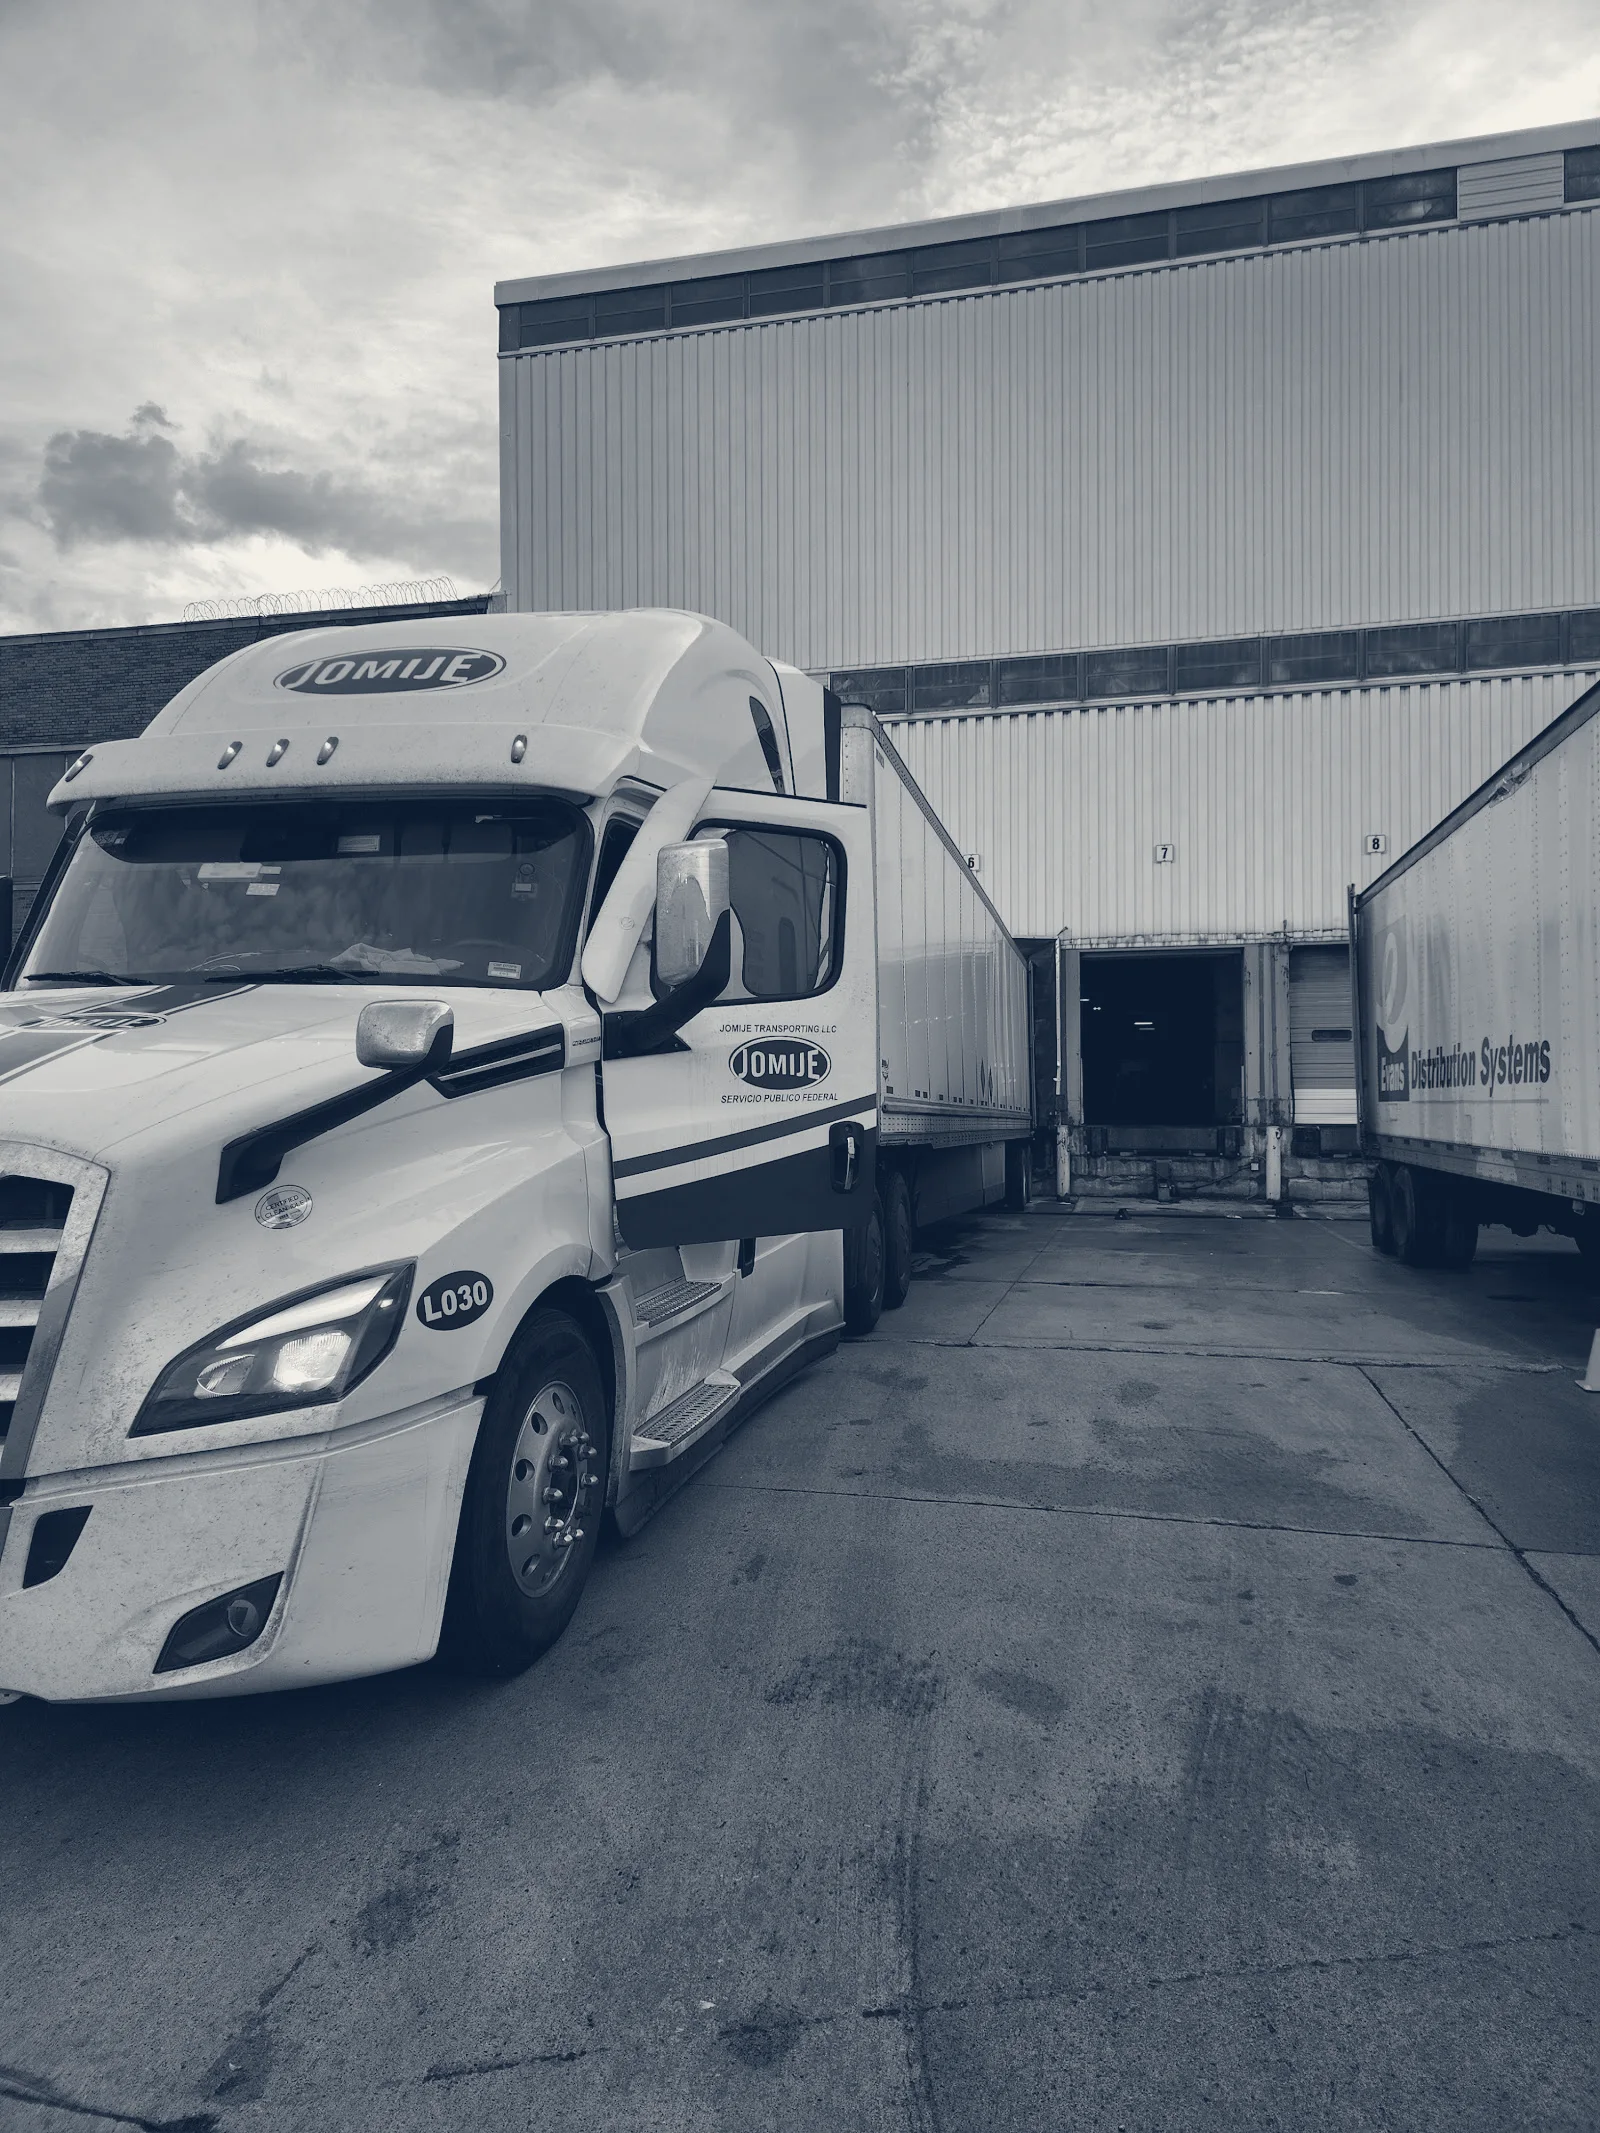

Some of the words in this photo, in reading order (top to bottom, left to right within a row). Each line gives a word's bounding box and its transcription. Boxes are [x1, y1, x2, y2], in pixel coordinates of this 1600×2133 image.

[283, 652, 483, 690] JOMIJE
[1372, 837, 1380, 850] 8
[1161, 847, 1168, 859] 7
[968, 856, 975, 868] 6
[719, 1024, 752, 1033] JOMIJE
[754, 1024, 820, 1033] TRANSPORTING
[821, 1024, 837, 1034] LLC
[738, 1048, 820, 1080] JOMIJE
[1381, 1056, 1405, 1092] Evans
[1411, 1042, 1477, 1090] Distribution
[1480, 1034, 1551, 1098] Systems
[721, 1094, 762, 1104] SERVICIO
[763, 1093, 801, 1103] PUBLICO
[802, 1093, 838, 1102] FEDERAL
[423, 1280, 488, 1323] L030
